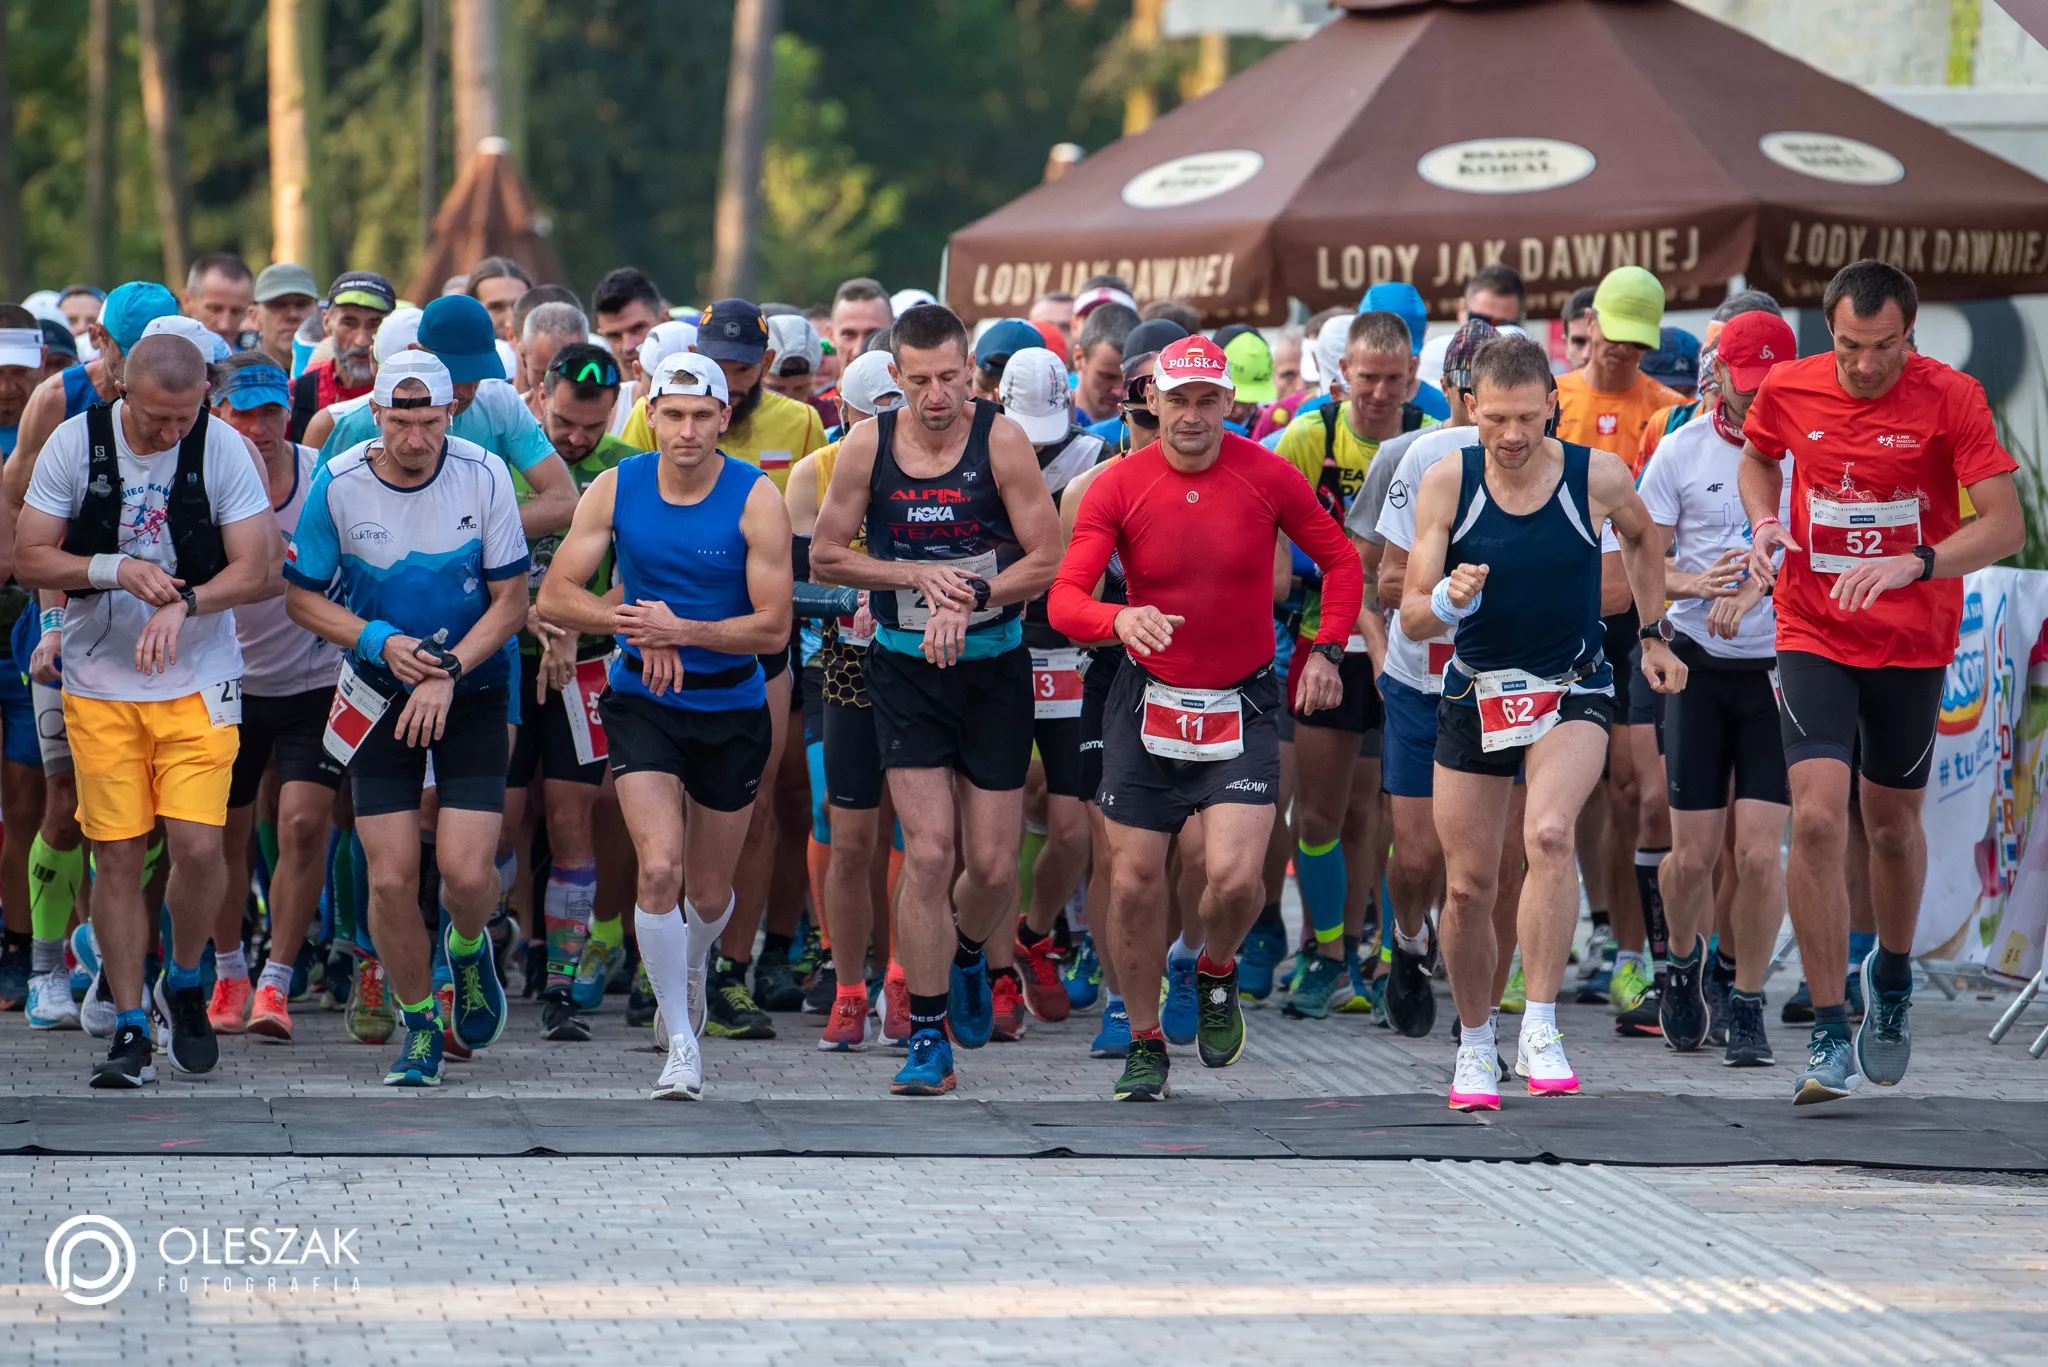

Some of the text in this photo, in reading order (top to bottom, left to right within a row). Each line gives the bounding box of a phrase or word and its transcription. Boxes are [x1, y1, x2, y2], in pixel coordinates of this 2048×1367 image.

[1785, 221, 1867, 268] LODY
[1876, 226, 1927, 273] JAK
[1317, 226, 1699, 290] LODY JAK DAWNIEJ
[973, 262, 1051, 306] LODY
[1117, 252, 1234, 300] DAWNIEJ
[1168, 357, 1221, 369] POLSKA
[1807, 431, 1825, 441] 4F
[121, 486, 144, 499] BIEG
[889, 488, 961, 501] ALPIN
[1707, 483, 1724, 493] 4F
[907, 506, 955, 522] HOKA
[351, 529, 388, 541] LukTrans
[888, 523, 979, 540] TEAM
[1846, 530, 1883, 555] 52
[1502, 697, 1535, 724] 62
[1592, 711, 1607, 723] asics
[1176, 714, 1204, 741] 11
